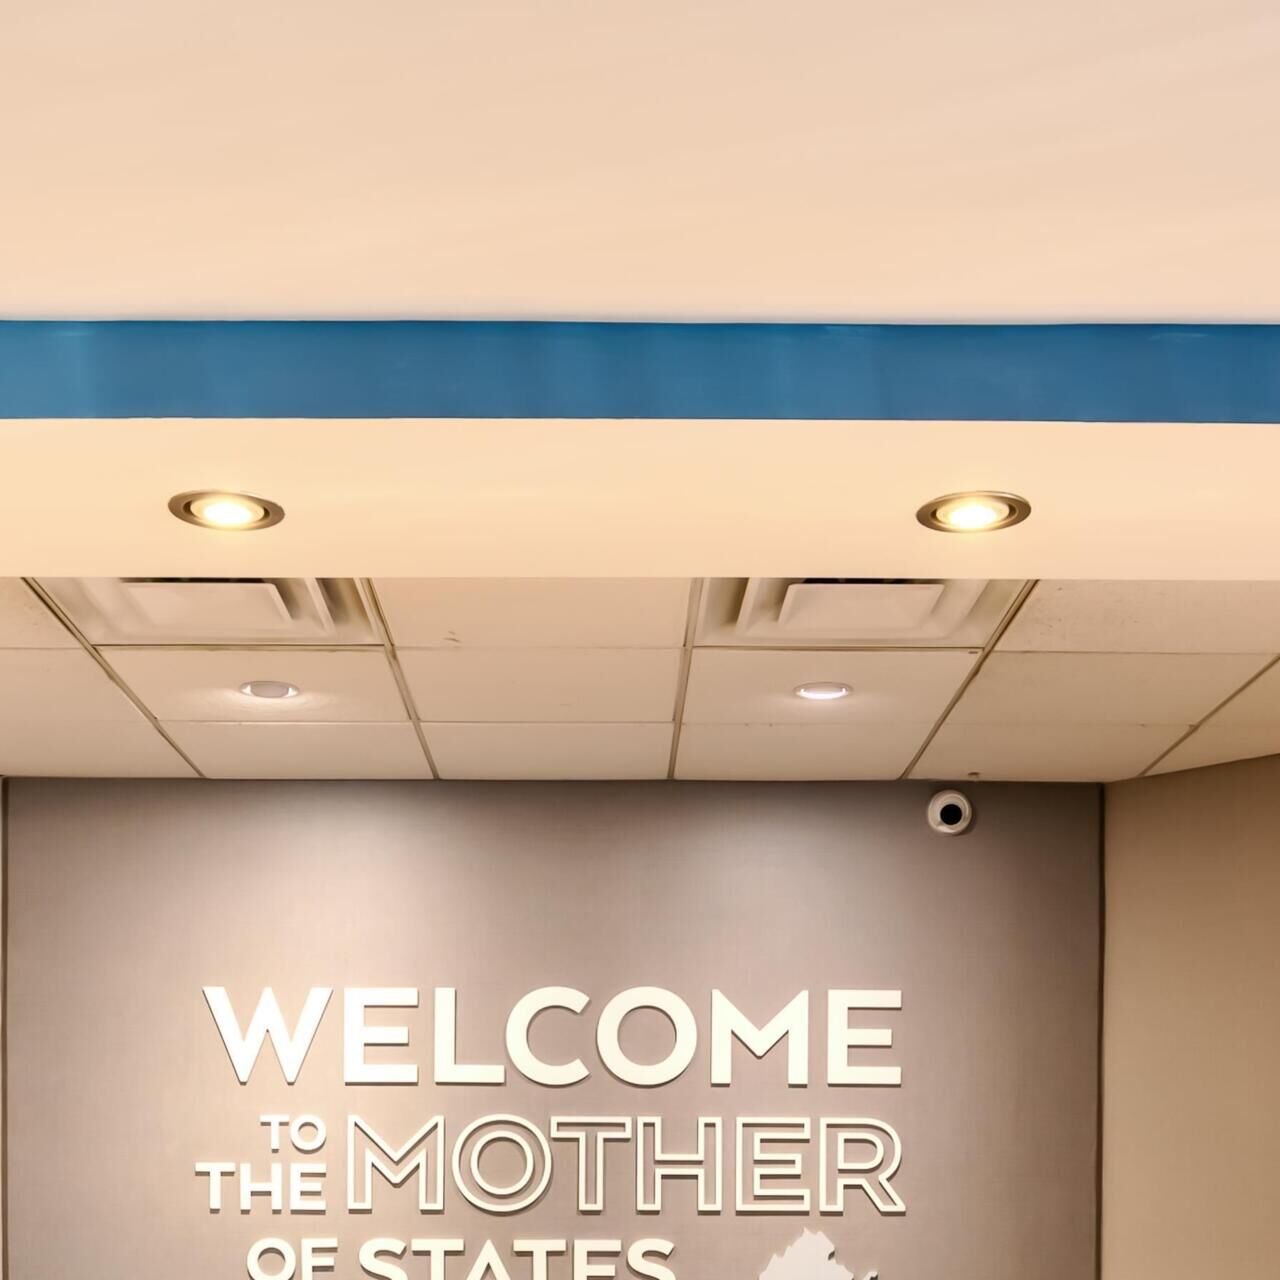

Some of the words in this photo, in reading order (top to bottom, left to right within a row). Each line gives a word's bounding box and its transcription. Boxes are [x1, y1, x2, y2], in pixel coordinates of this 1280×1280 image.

[202, 986, 902, 1086] WELCOME
[260, 1114, 327, 1152] TO
[346, 1113, 906, 1213] MOTHER
[195, 1162, 327, 1212] THE
